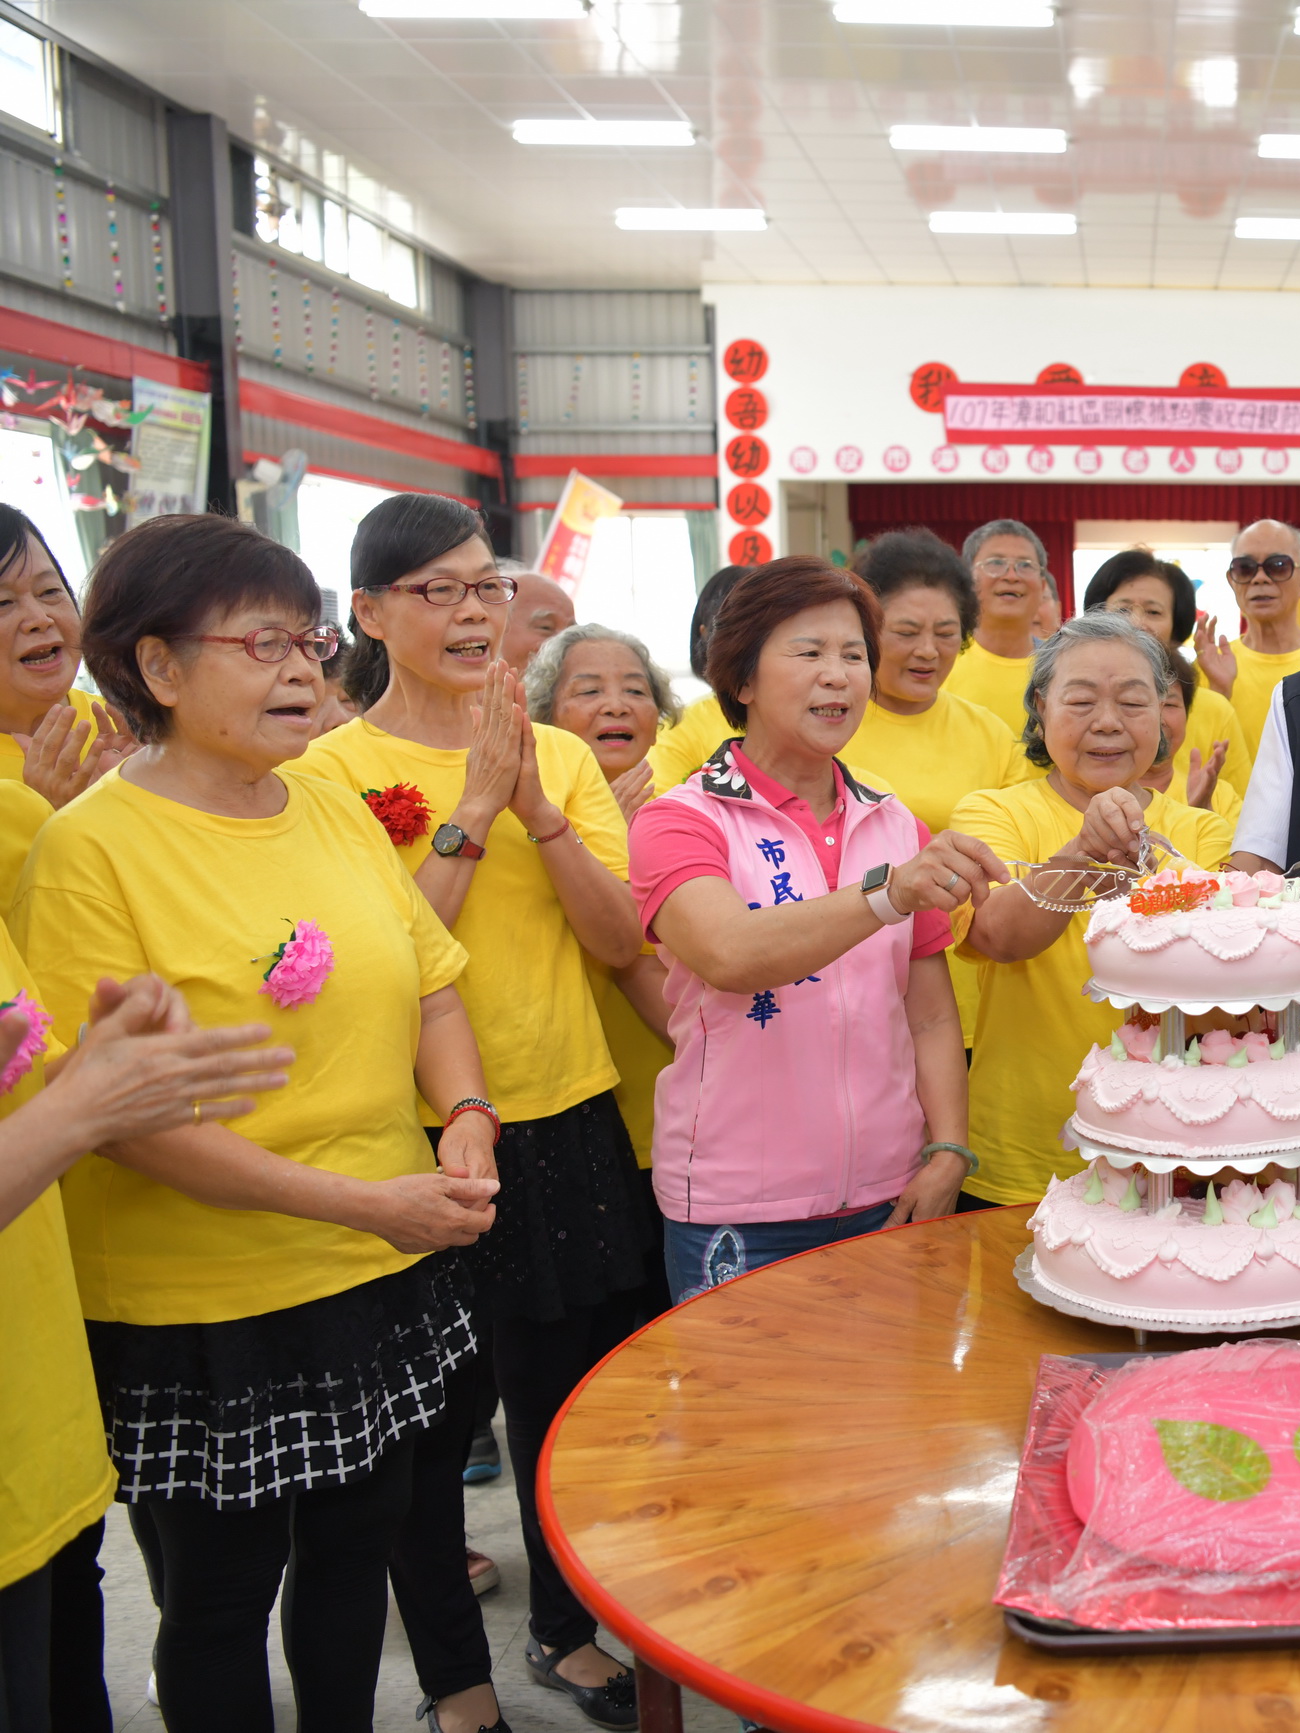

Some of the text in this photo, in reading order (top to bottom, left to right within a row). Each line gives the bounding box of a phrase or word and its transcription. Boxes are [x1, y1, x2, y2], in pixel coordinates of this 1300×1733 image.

[729, 345, 768, 567] 幼吾幼以及
